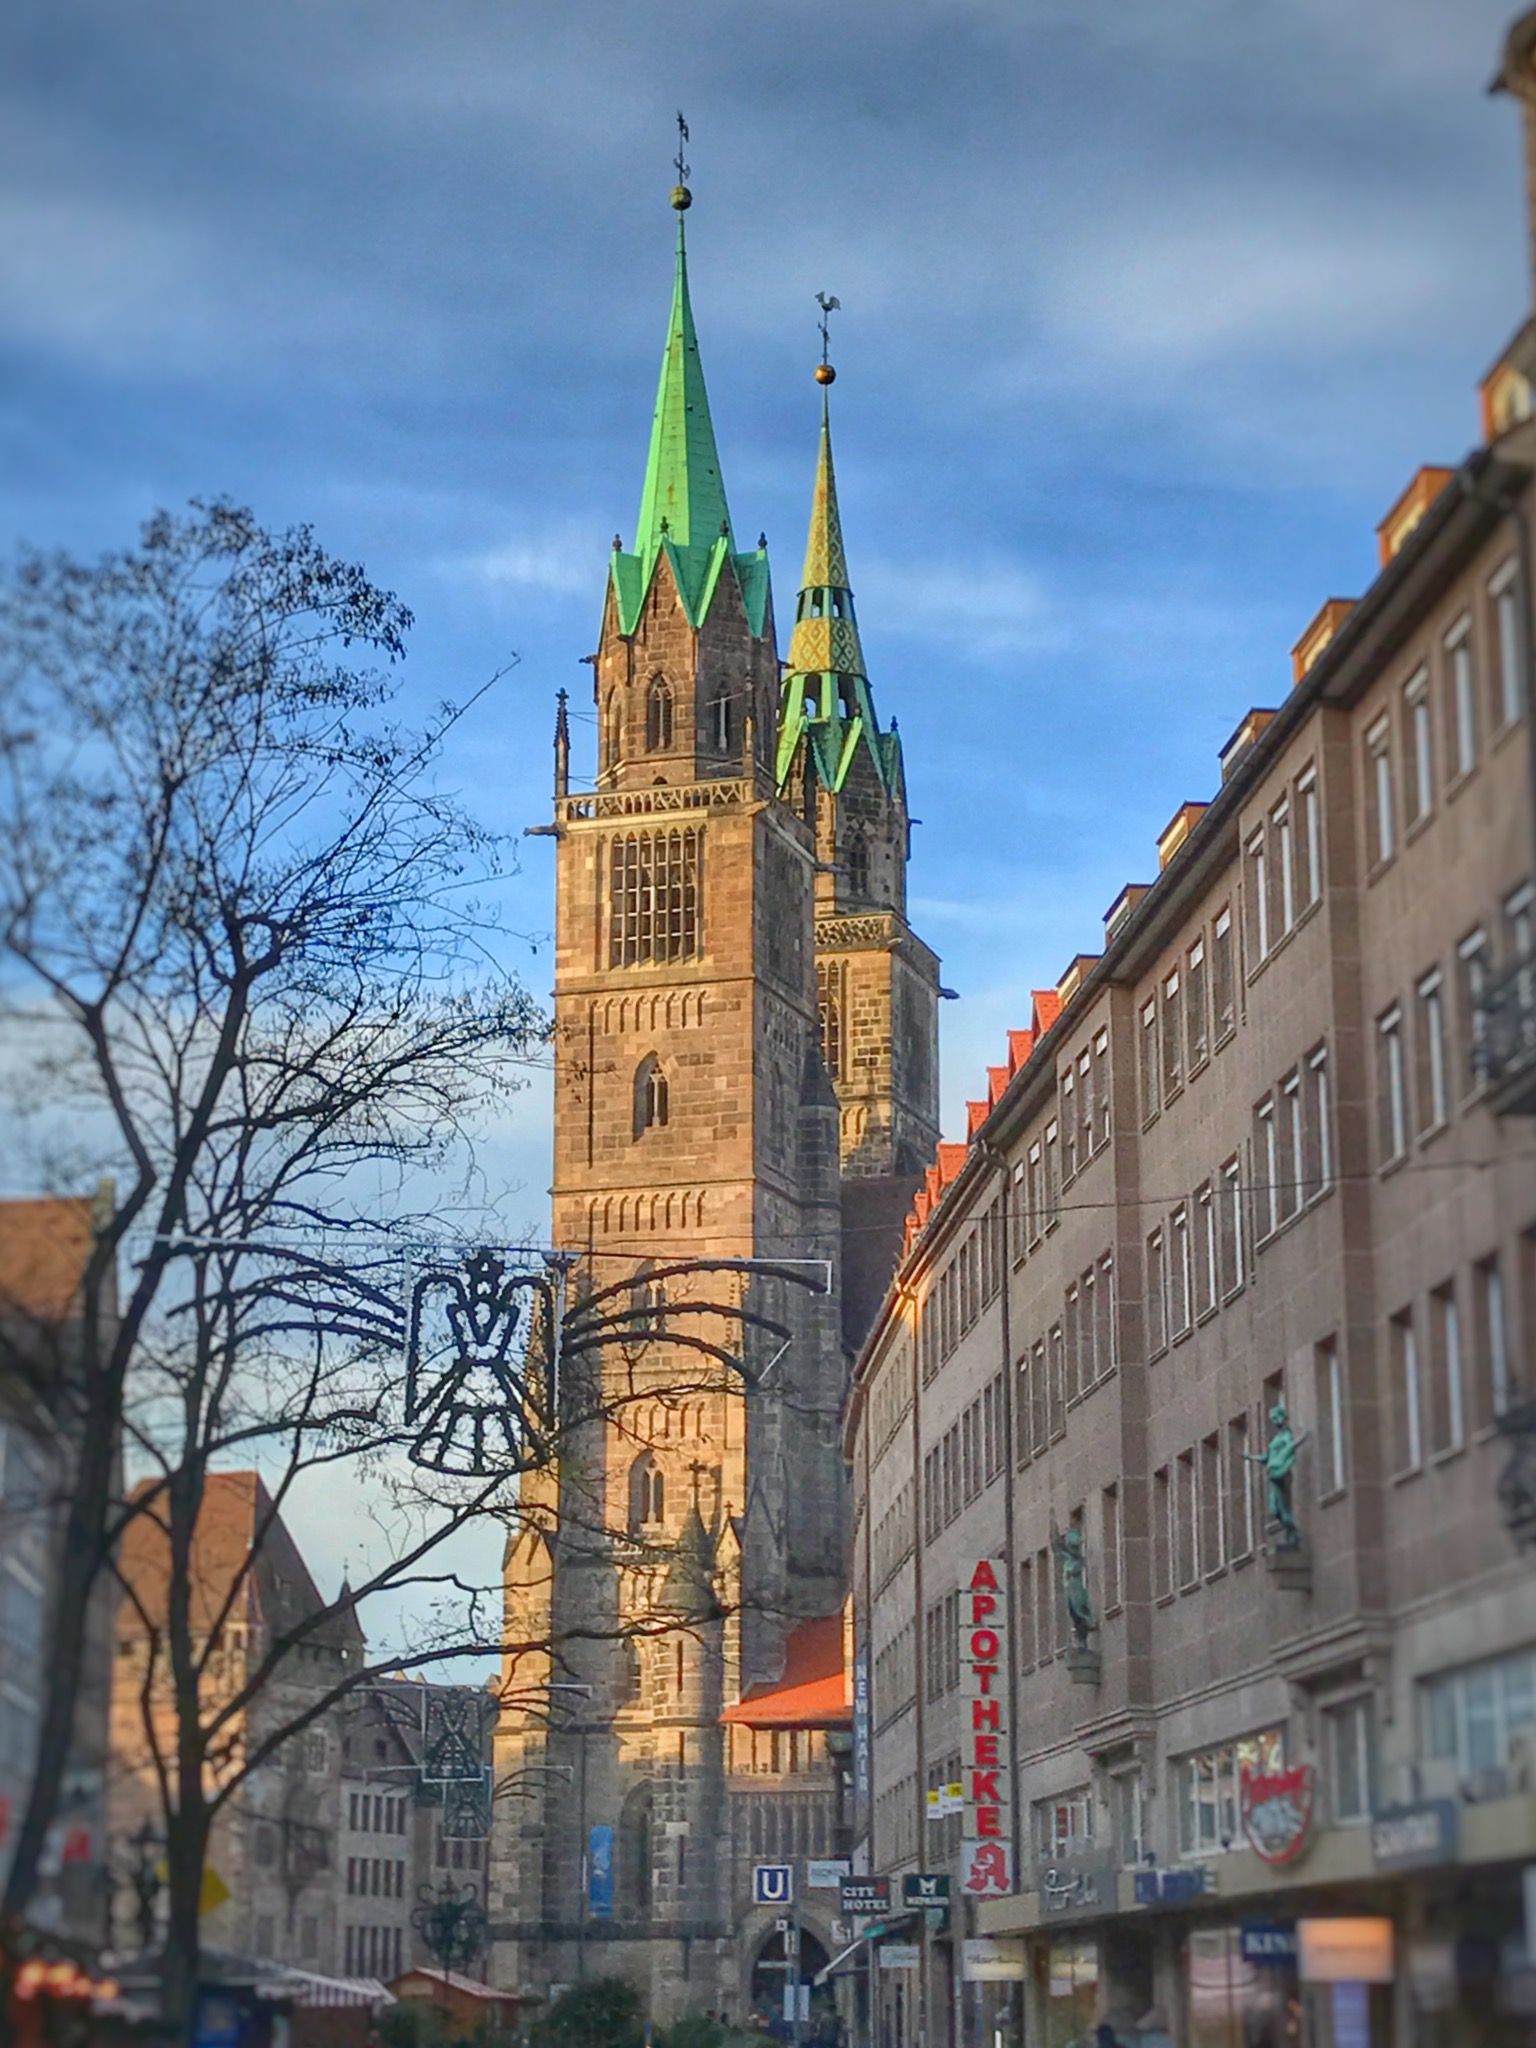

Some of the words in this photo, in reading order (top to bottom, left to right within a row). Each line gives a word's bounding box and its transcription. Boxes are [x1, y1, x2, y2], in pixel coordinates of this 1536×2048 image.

[856, 1664, 868, 1714] NEW
[970, 1560, 1002, 1837] APOTHEKE
[857, 1724, 869, 1791] HAIR
[762, 1871, 784, 1899] U
[842, 1886, 875, 1898] CITY
[843, 1898, 889, 1911] HOTEL
